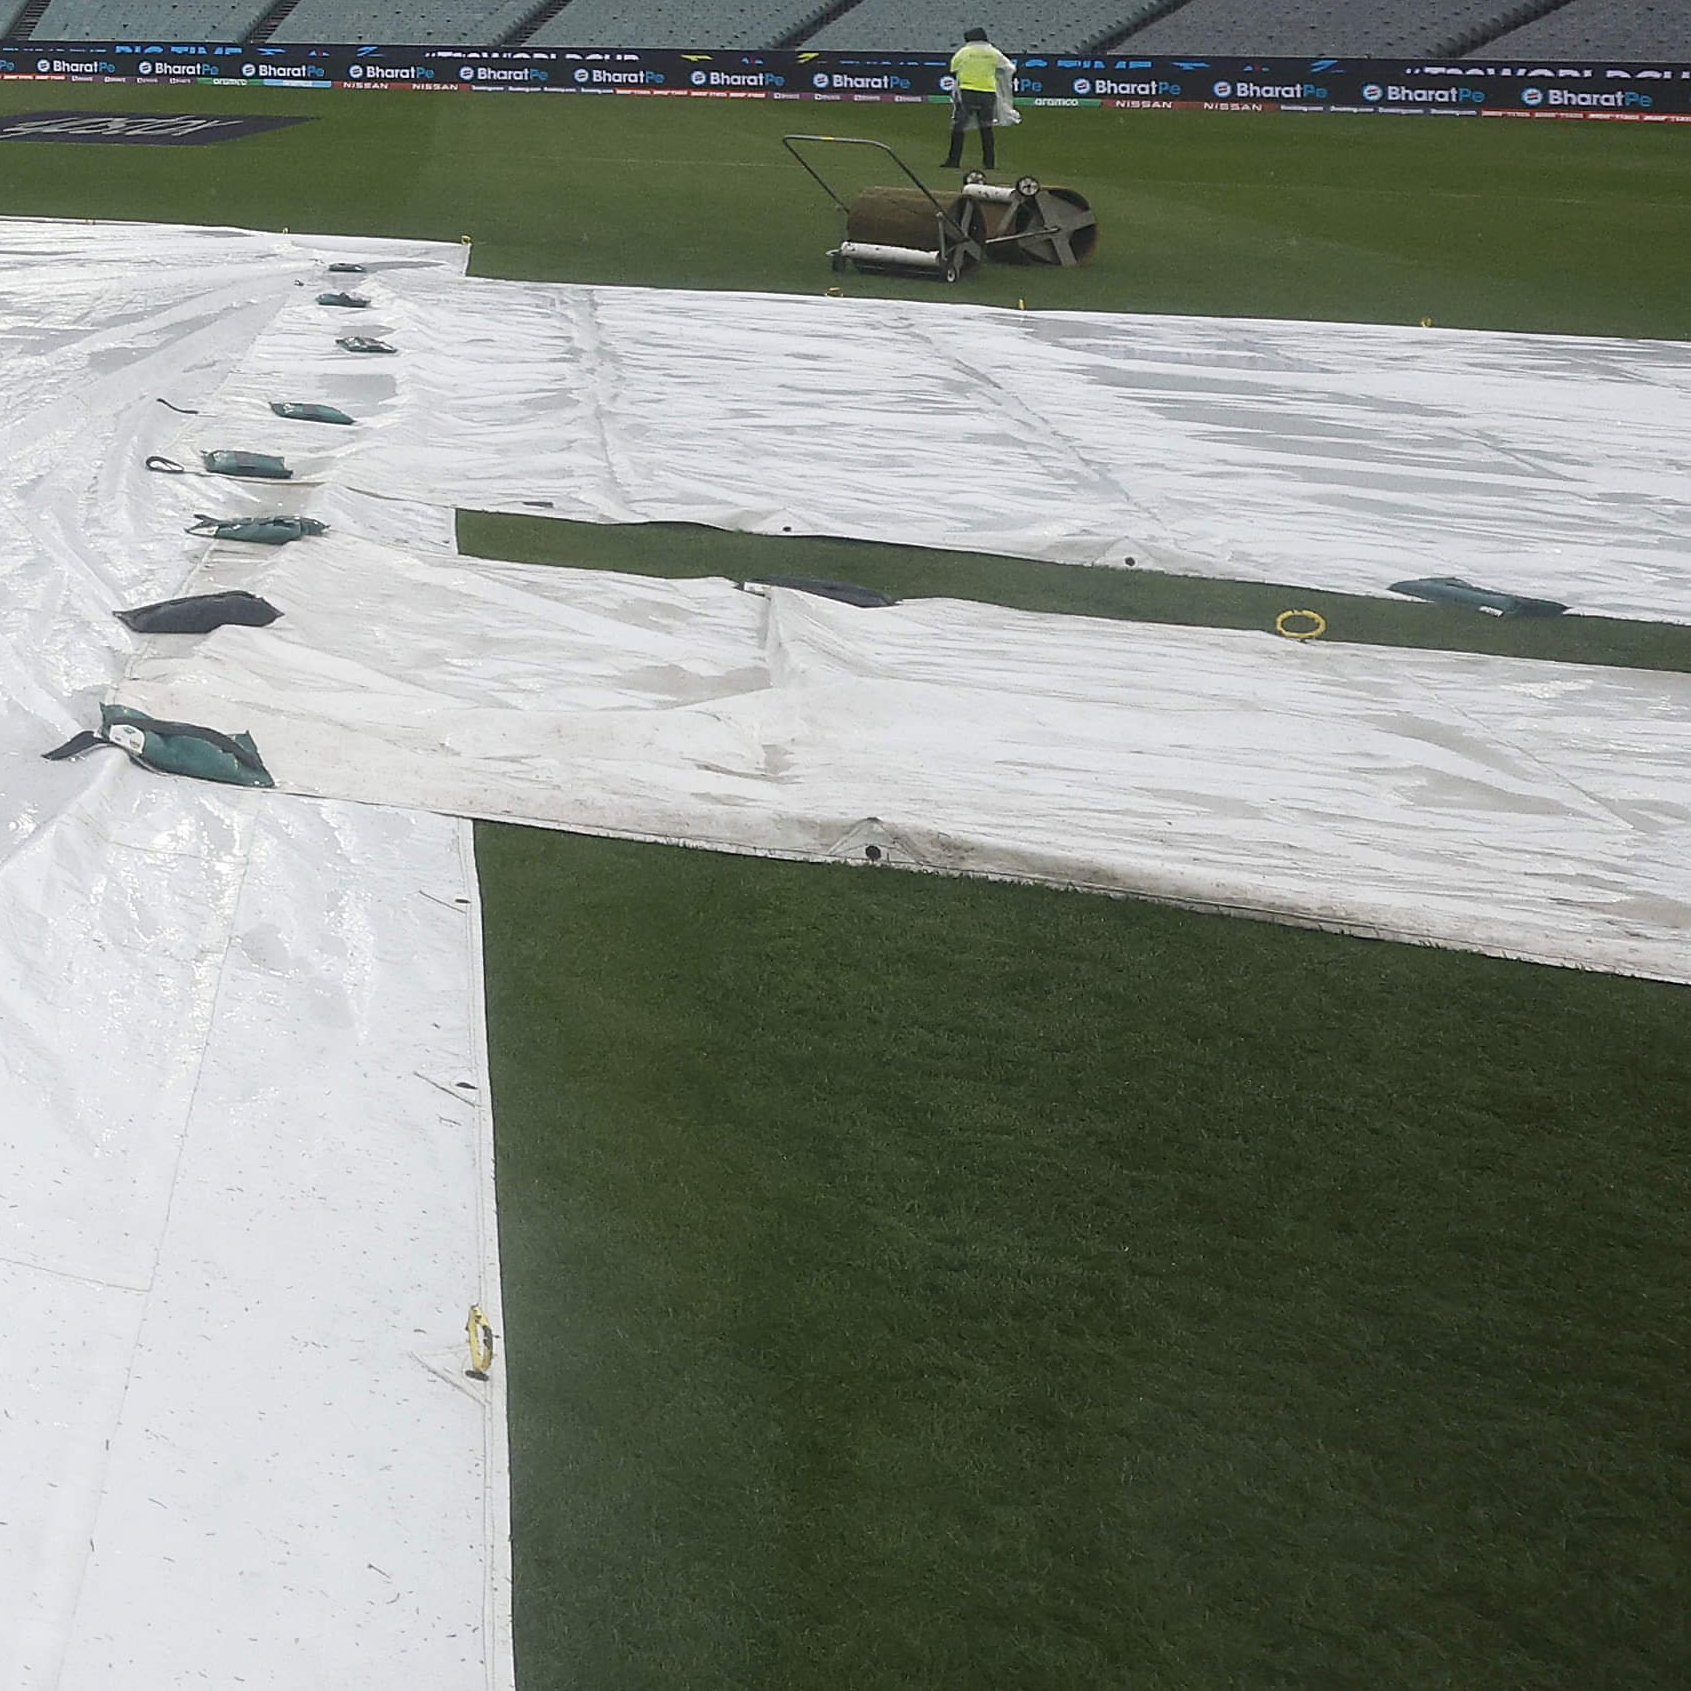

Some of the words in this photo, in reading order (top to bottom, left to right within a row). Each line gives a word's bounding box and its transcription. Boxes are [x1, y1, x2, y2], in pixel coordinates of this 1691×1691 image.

[53, 61, 116, 73] BharatPe
[259, 64, 325, 78] BharatPe
[477, 67, 549, 81] BharatPe
[710, 72, 785, 86] BharatPe
[1095, 79, 1181, 96] BharatPe
[1387, 85, 1485, 102] BharatPe
[1035, 97, 1079, 107] aramco
[1116, 100, 1173, 108] NISSAN
[1548, 90, 1652, 107] BharatPe
[1204, 102, 1262, 110] NISSAN
